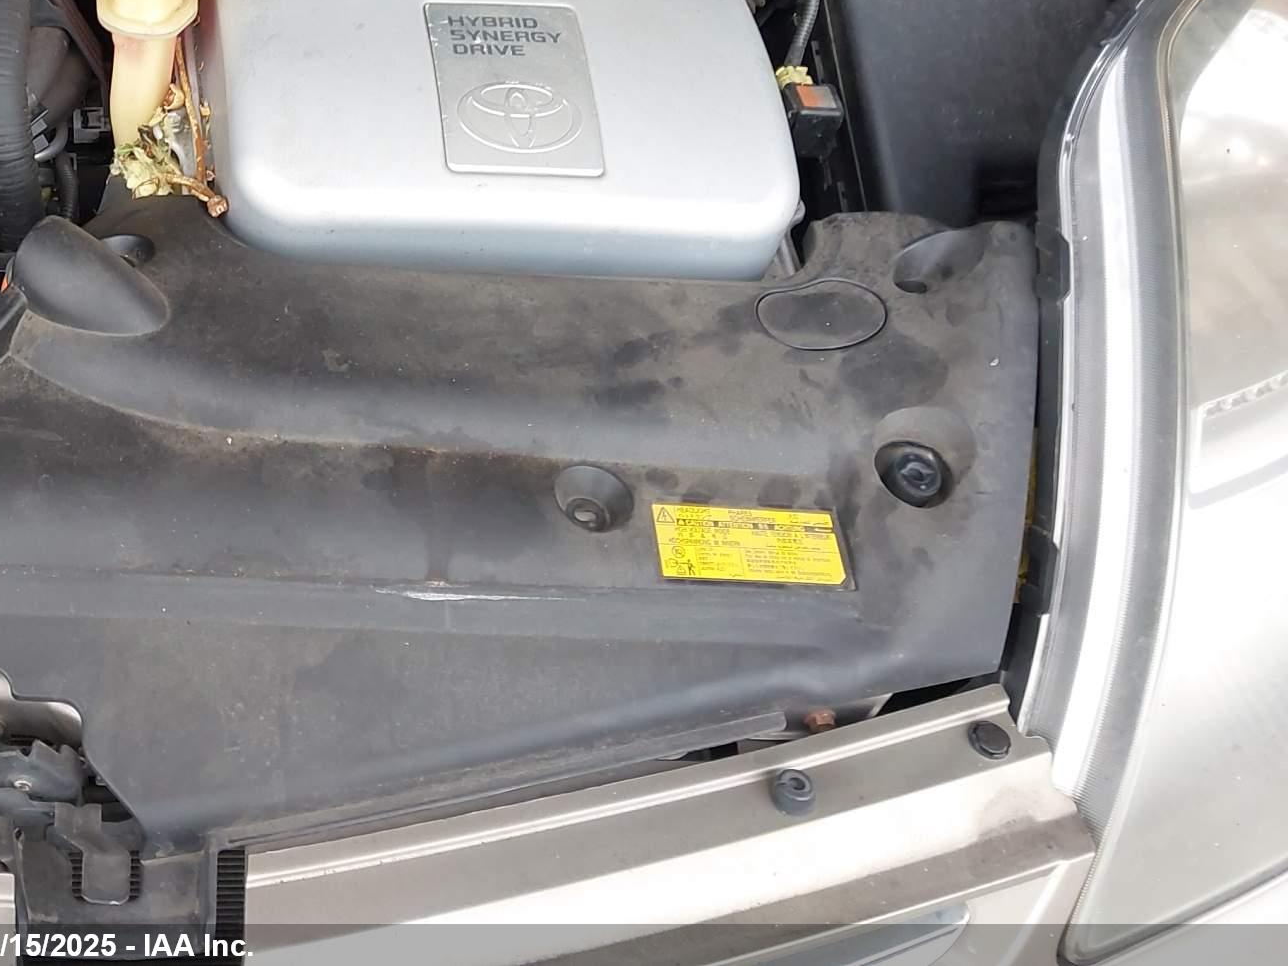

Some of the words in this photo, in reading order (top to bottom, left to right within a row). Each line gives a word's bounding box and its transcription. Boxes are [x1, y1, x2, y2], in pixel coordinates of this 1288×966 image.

[447, 15, 538, 29] HYBRID
[450, 29, 562, 44] SYNERGY
[453, 43, 526, 57] DRIVE
